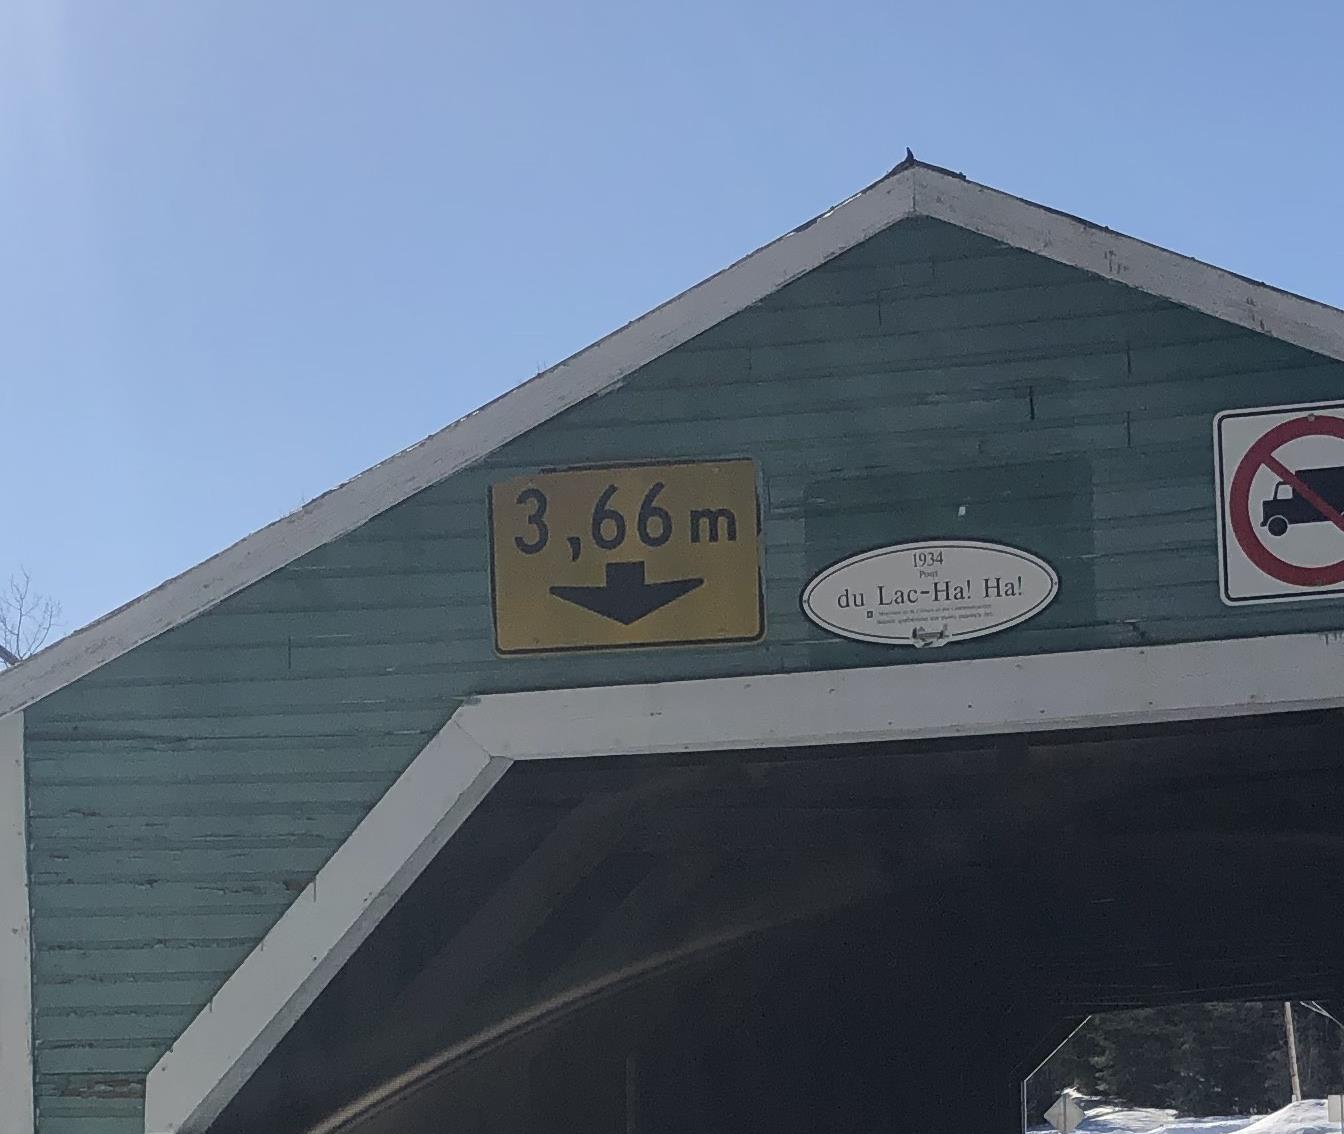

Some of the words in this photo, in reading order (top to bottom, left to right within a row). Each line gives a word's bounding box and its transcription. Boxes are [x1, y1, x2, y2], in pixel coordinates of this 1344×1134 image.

[514, 482, 673, 562] 3,66
[690, 507, 737, 543] m
[913, 551, 944, 568] 1934
[837, 589, 865, 609] du
[877, 579, 972, 606] Lac-Ha!
[983, 576, 1023, 599] Ha!
